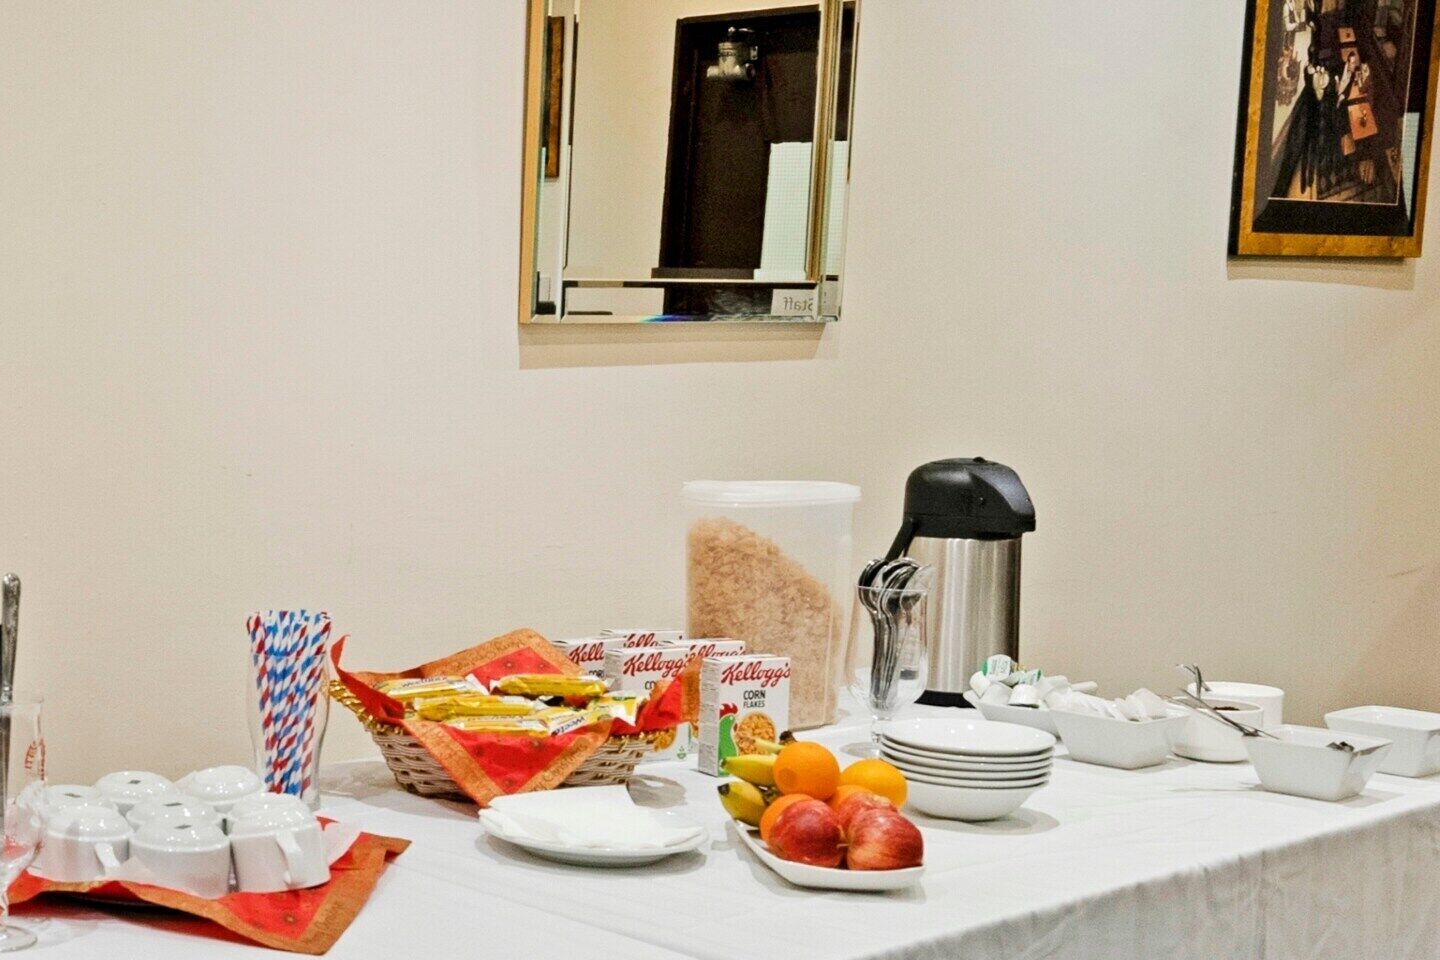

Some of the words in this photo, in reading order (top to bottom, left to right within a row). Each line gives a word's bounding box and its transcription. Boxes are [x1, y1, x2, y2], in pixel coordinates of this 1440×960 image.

[721, 661, 791, 687] Kellogg's
[743, 690, 766, 701] CORN
[743, 700, 766, 709] FLAKES
